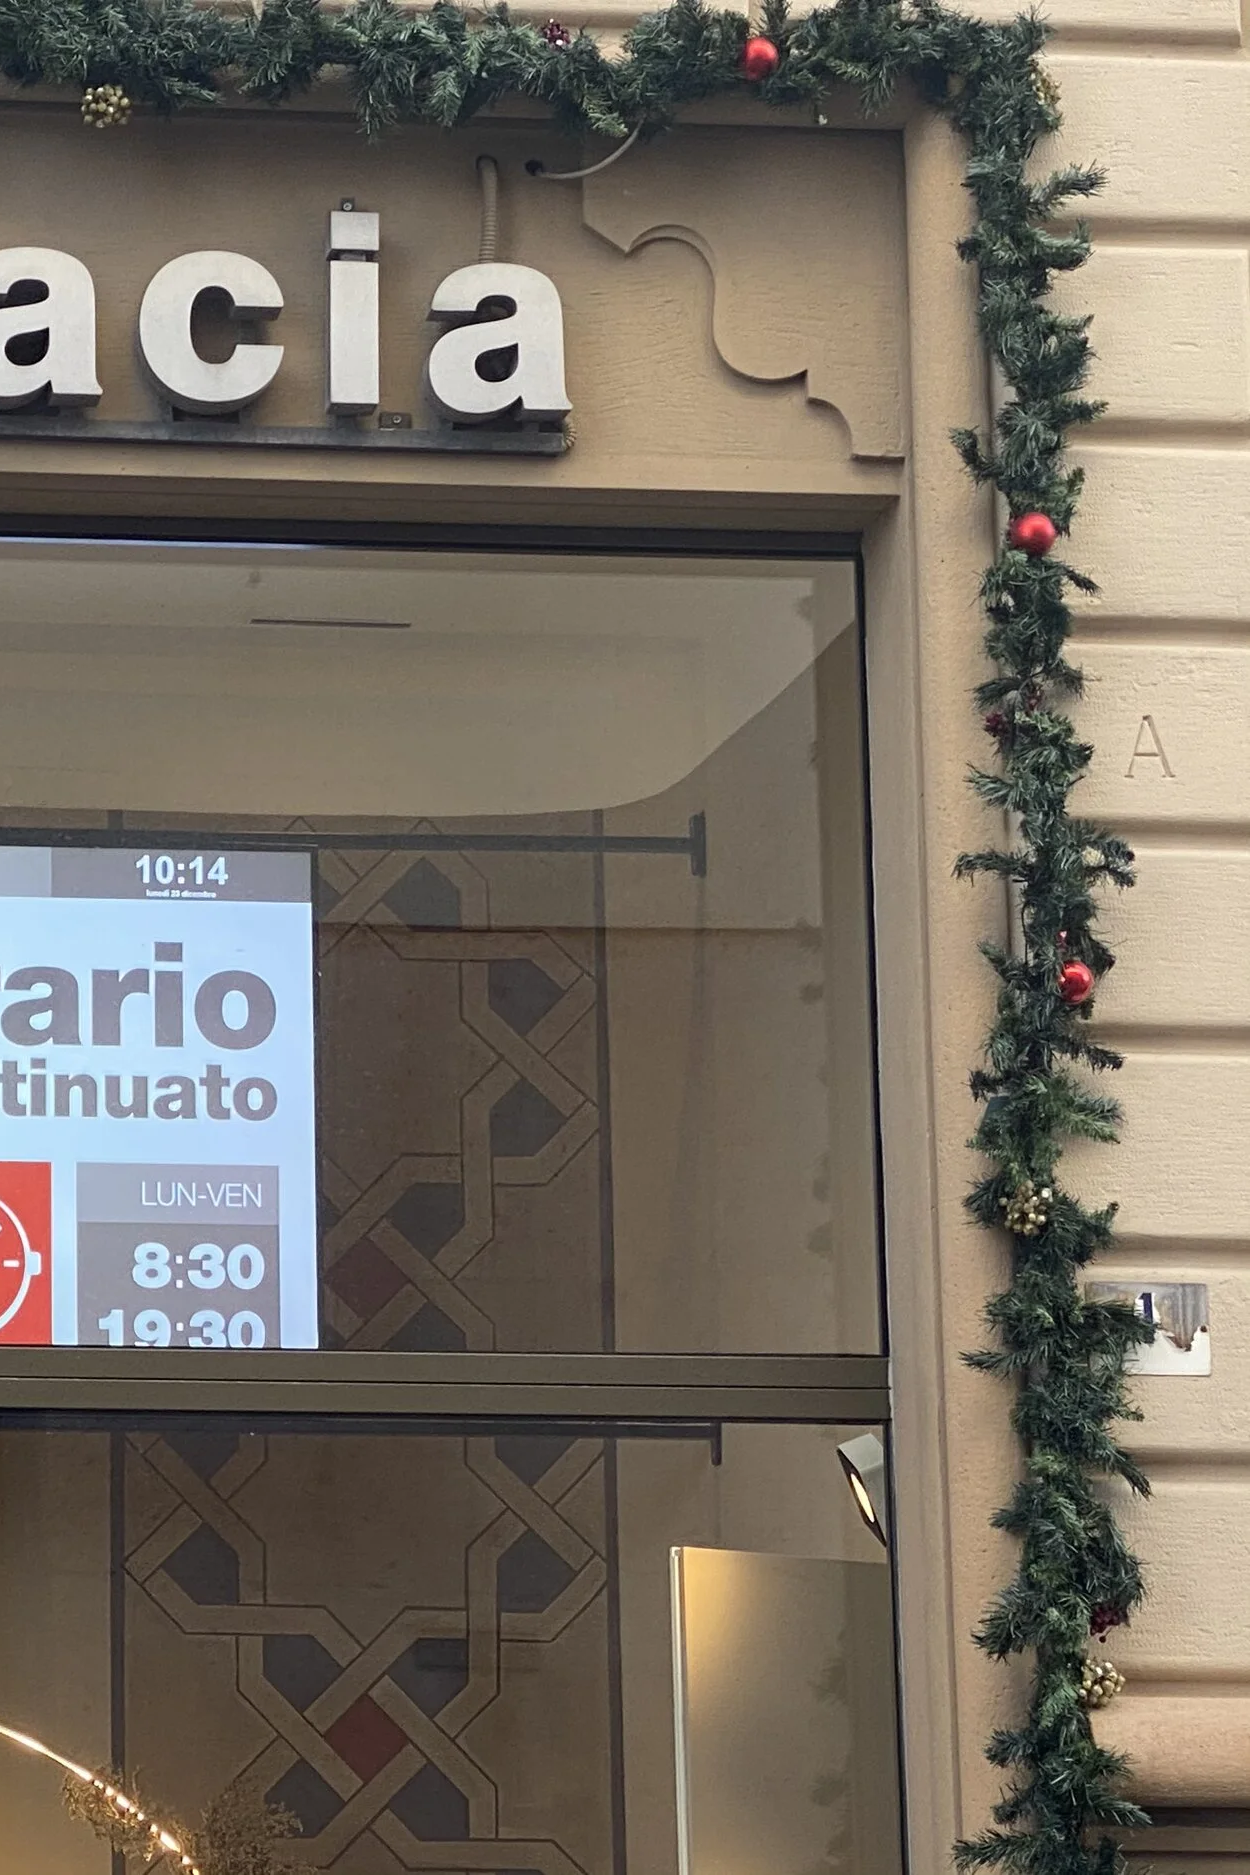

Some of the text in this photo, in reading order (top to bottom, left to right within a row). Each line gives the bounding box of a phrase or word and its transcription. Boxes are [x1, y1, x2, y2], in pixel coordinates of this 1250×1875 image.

[1124, 715, 1176, 778] A
[135, 854, 229, 886] 10:14
[141, 1180, 263, 1209] LUN-VEN
[131, 1241, 266, 1291] 8:30
[98, 1308, 266, 1348] 19:30
